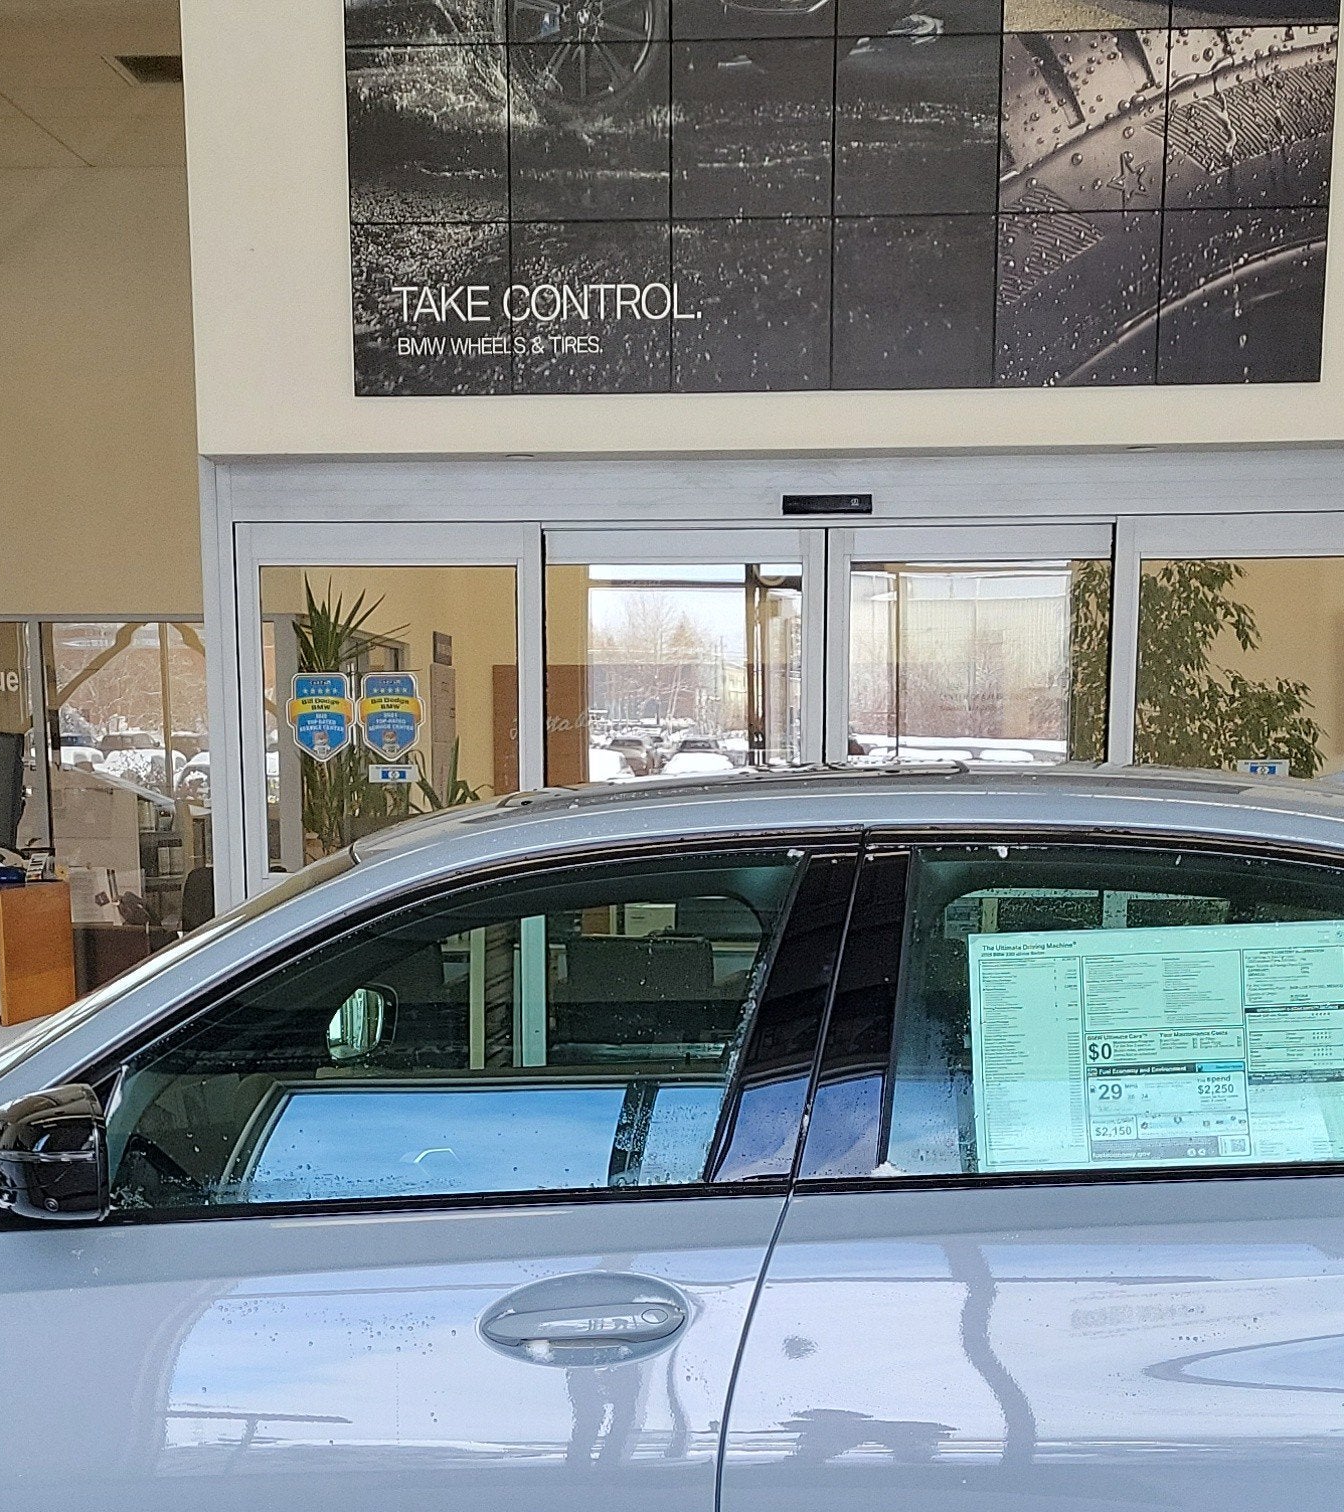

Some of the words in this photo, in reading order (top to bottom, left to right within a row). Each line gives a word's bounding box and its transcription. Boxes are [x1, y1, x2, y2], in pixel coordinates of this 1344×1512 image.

[392, 285, 490, 322] TAKE
[502, 283, 702, 321] CONTROL.
[397, 336, 446, 356] BMW
[451, 336, 526, 355] WHEELS
[531, 336, 545, 354] &
[549, 336, 603, 354] TIRES.
[1088, 1042, 1112, 1062] $0
[1112, 1067, 1138, 1075] Economy
[1207, 1075, 1231, 1083] spend
[1099, 1084, 1123, 1100] 29
[1197, 1084, 1234, 1094] $2,250
[1095, 1126, 1132, 1136] $2,150
